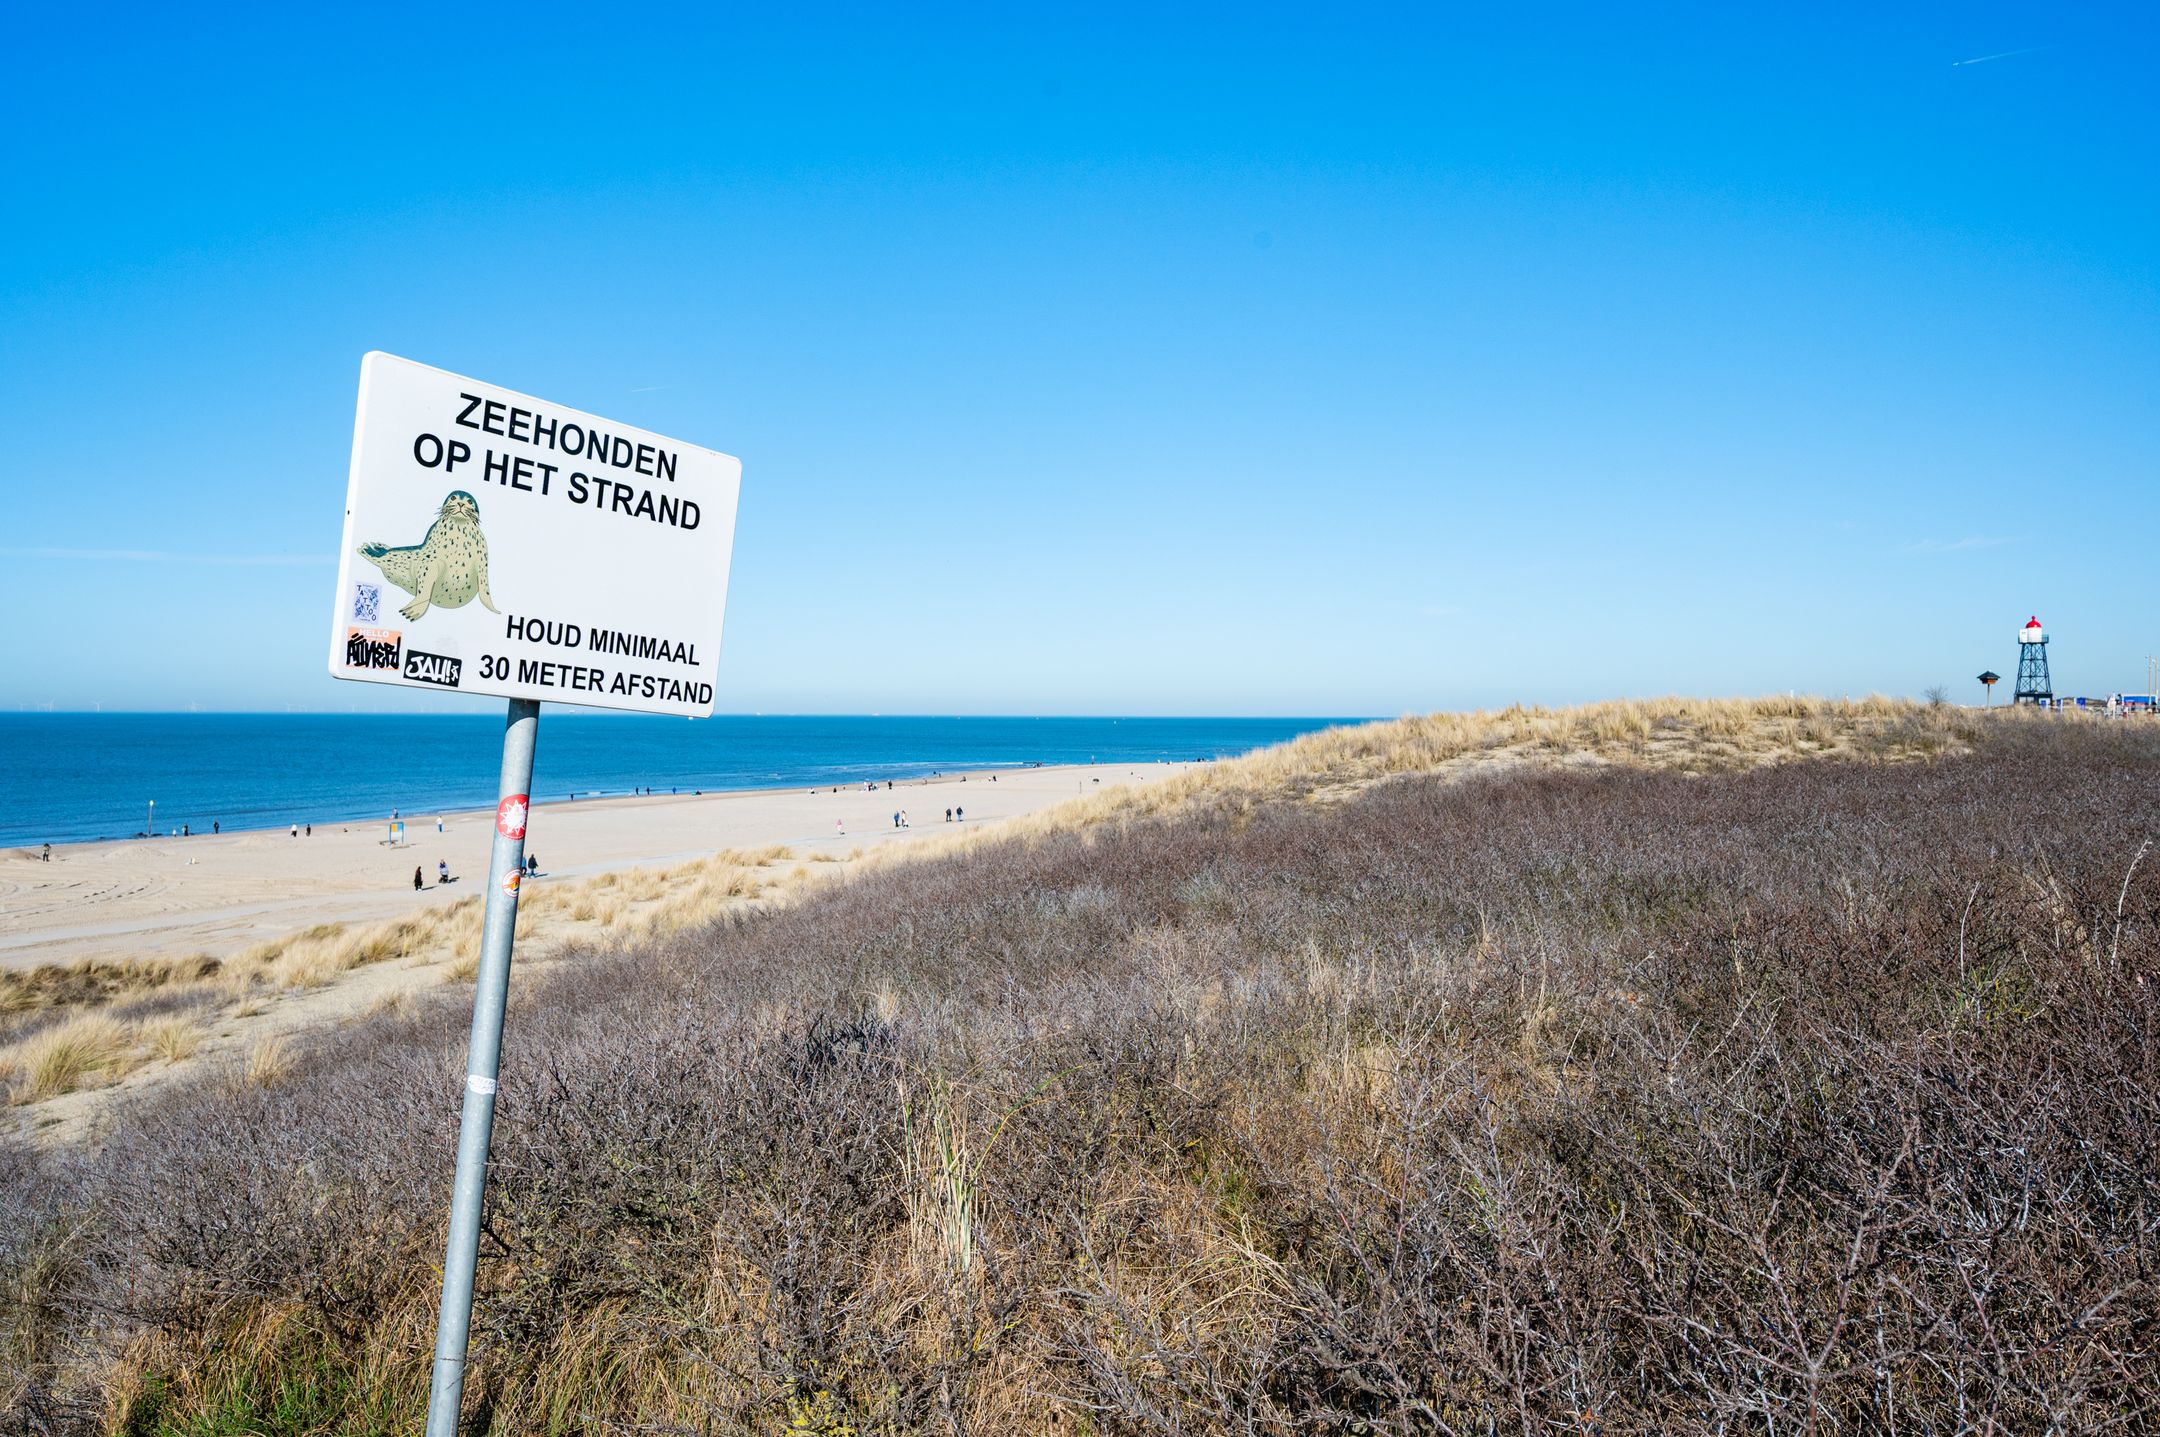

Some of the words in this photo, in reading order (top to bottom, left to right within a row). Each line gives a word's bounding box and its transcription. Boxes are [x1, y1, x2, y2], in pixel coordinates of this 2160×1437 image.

[456, 392, 678, 481] ZEEHONDEN
[413, 433, 471, 473] OP
[483, 450, 559, 496] HET
[568, 473, 701, 530] STRAND
[359, 628, 389, 638] HELLO
[506, 615, 582, 648] HOUD
[589, 628, 700, 666] MINIMAAL
[479, 655, 510, 681] 30
[517, 660, 605, 693] METER
[610, 673, 713, 705] AFSTAND
